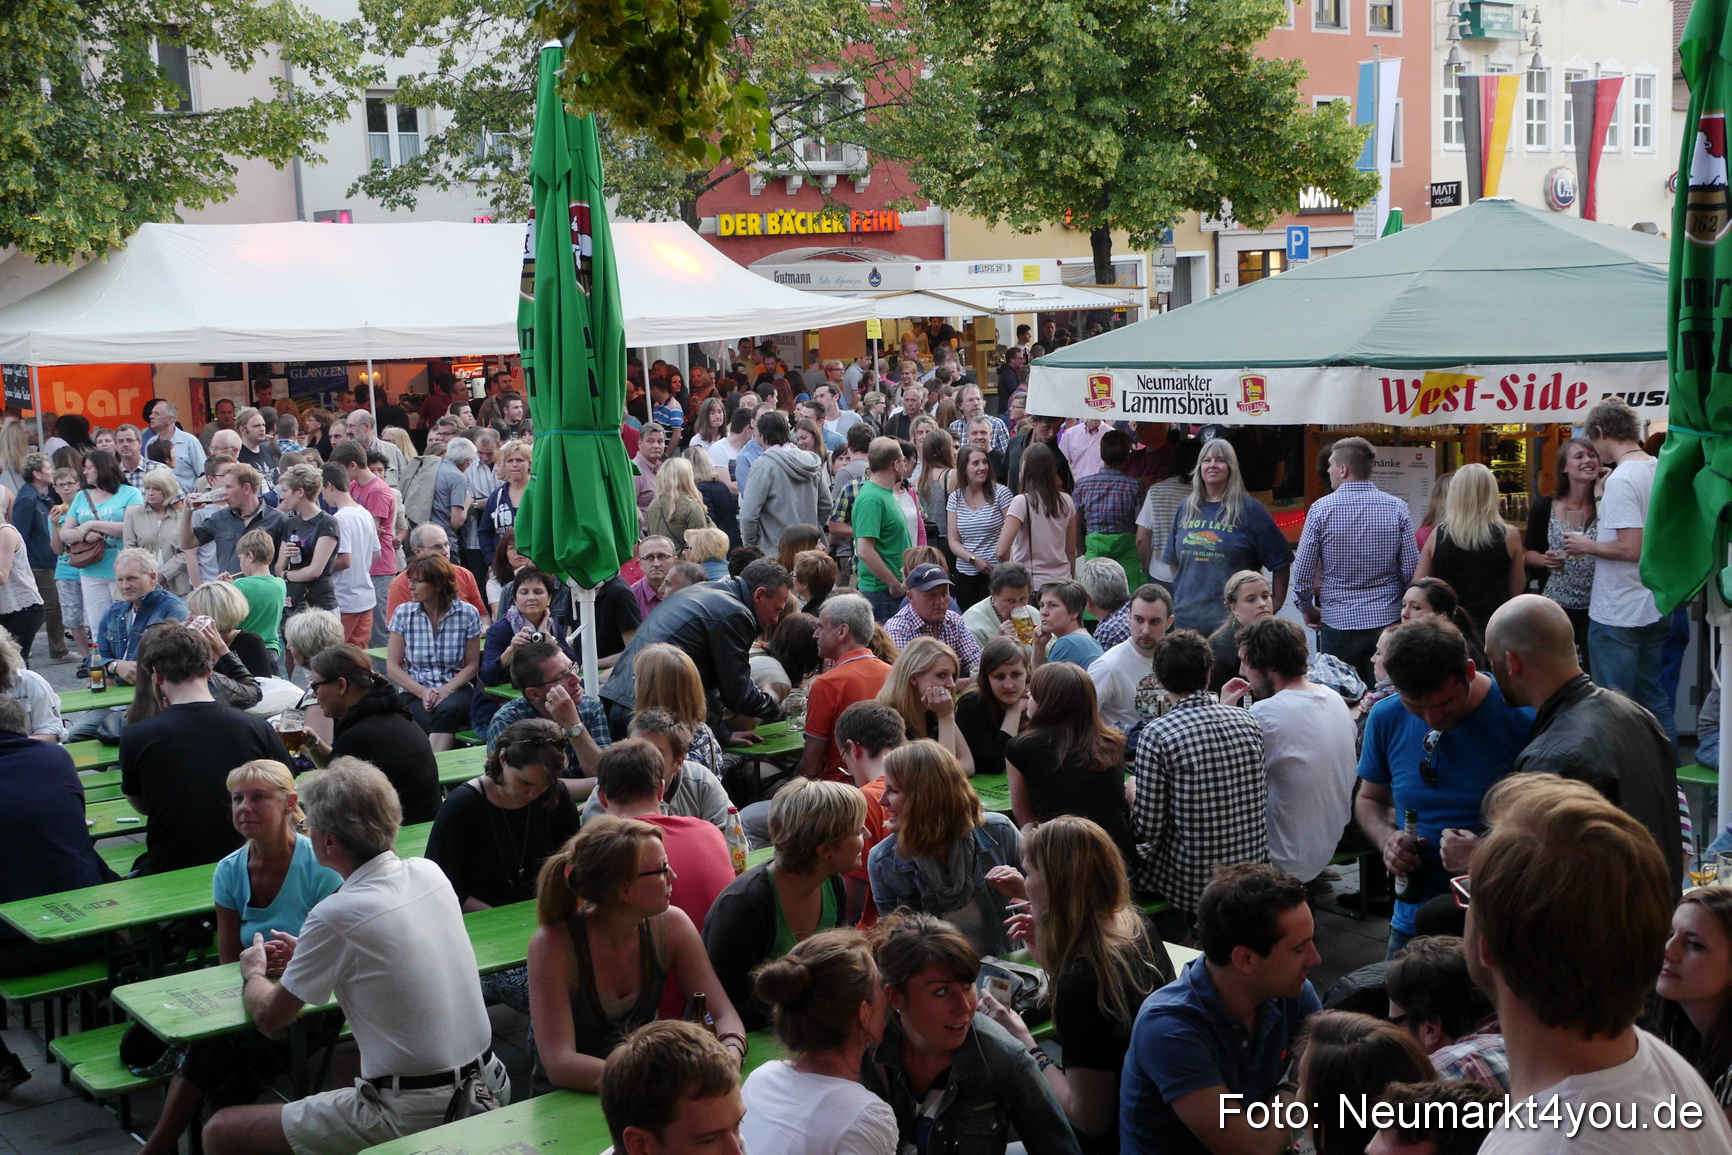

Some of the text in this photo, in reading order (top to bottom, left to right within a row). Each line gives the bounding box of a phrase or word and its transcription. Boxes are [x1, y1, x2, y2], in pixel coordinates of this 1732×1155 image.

[1432, 184, 1458, 196] MATT
[1556, 178, 1575, 198] C&A
[1434, 195, 1454, 206] optik
[719, 213, 762, 237] DER
[767, 208, 846, 235] BÄCKER
[1291, 230, 1305, 256] P
[774, 270, 811, 285] Gutmann
[1136, 374, 1212, 392] Neumarkter
[1378, 372, 1588, 415] West-Side
[52, 381, 139, 418] bar
[1122, 390, 1229, 416] Lammsbräu
